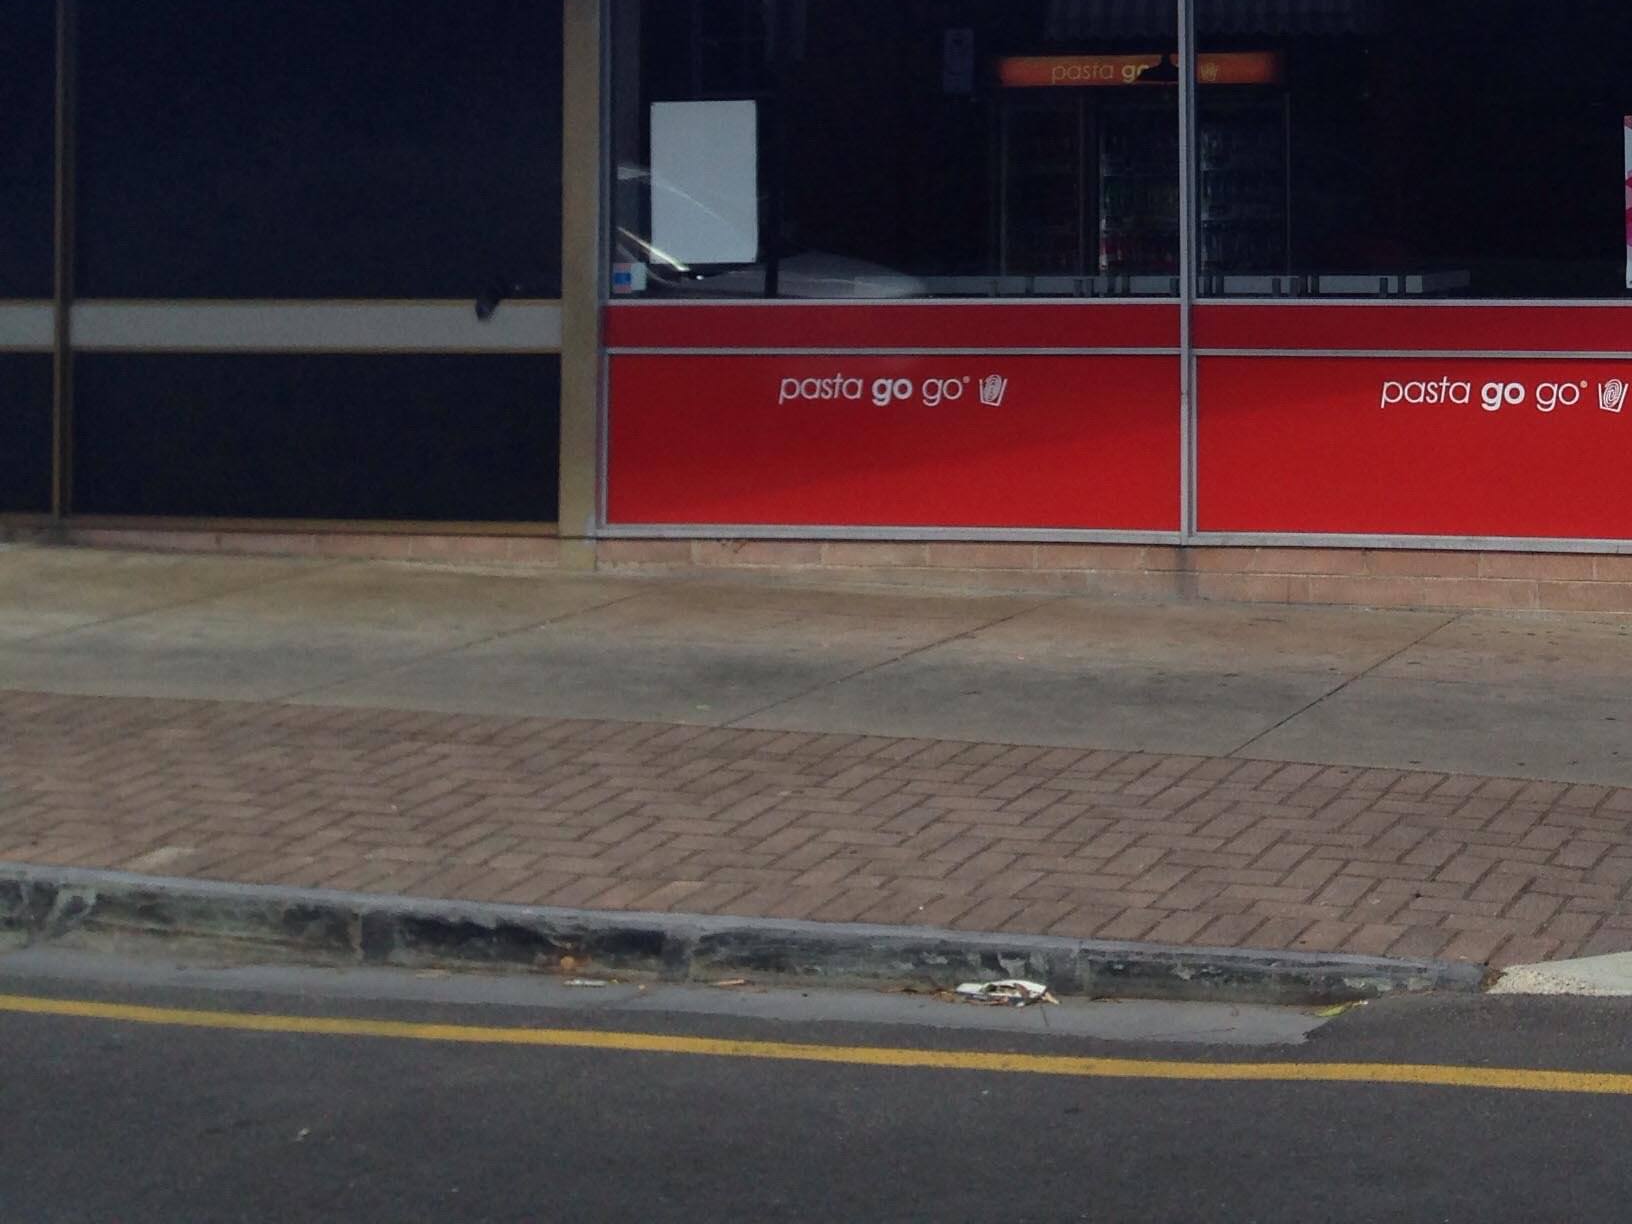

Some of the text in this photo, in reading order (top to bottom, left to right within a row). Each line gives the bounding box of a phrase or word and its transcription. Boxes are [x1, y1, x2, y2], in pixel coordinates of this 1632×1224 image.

[1051, 62, 1114, 84] pasta
[779, 373, 864, 405] pasta
[872, 378, 913, 406] go
[1381, 376, 1471, 408] pasta
[1481, 382, 1525, 411] go
